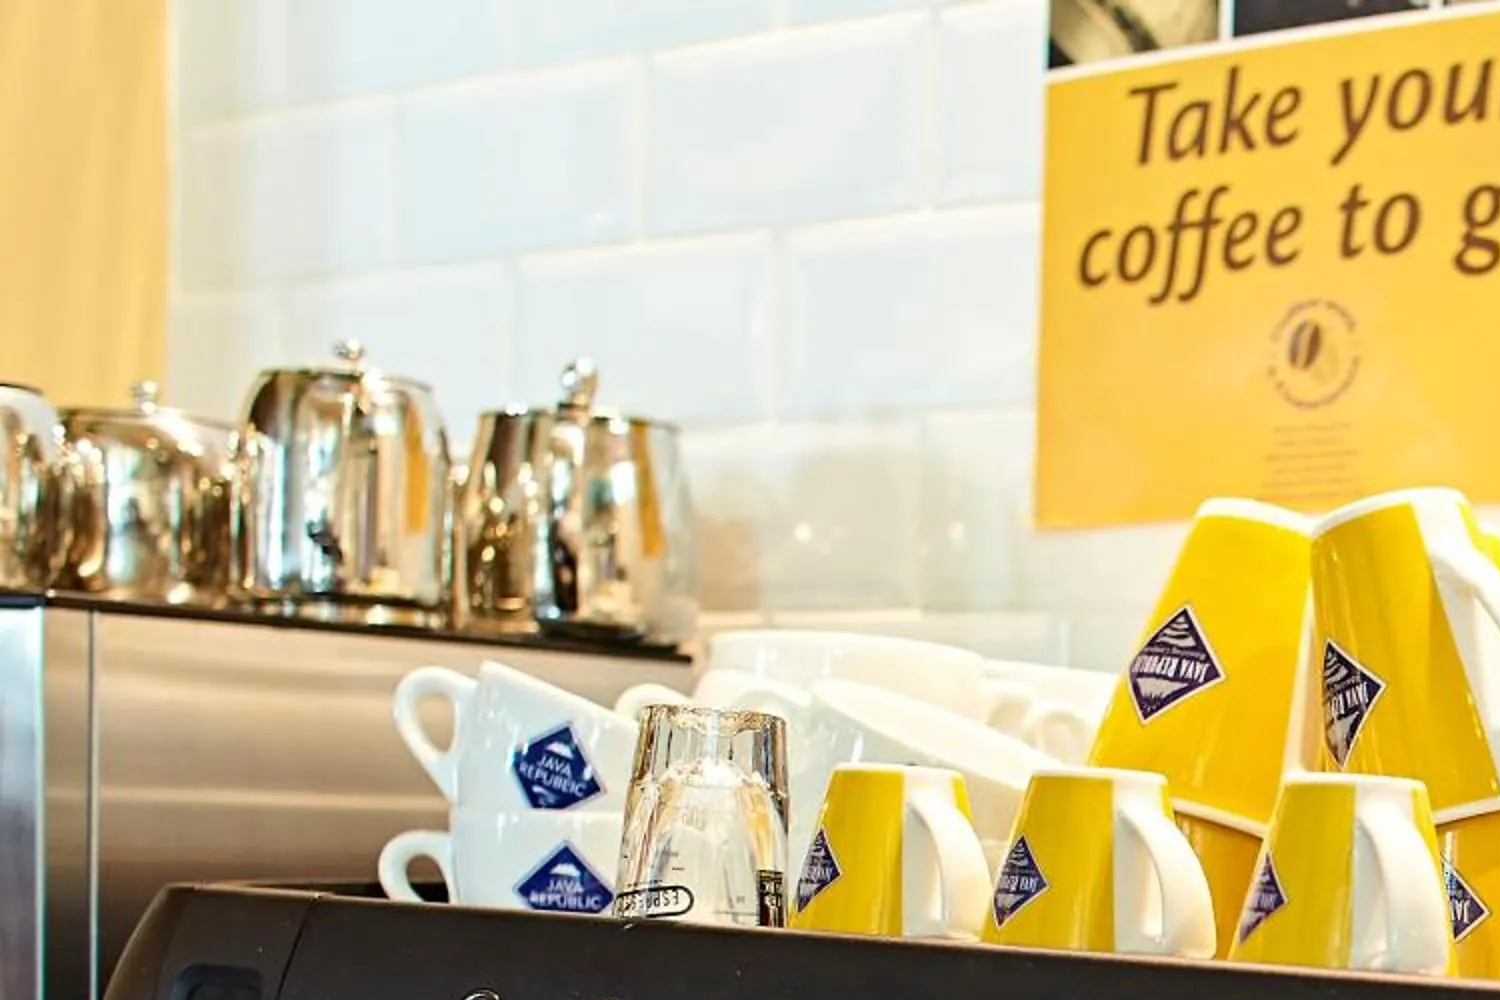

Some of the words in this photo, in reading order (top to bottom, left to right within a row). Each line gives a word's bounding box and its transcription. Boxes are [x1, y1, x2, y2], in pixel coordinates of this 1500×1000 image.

[1128, 64, 1303, 166] Take
[1078, 184, 1303, 307] coffee
[1338, 182, 1422, 261] to
[1180, 659, 1210, 684] JAVA
[519, 760, 587, 799] REPUBLIC
[537, 754, 572, 783] JAVA
[529, 890, 602, 911] REPUBLIC
[546, 878, 584, 894] JAVA
